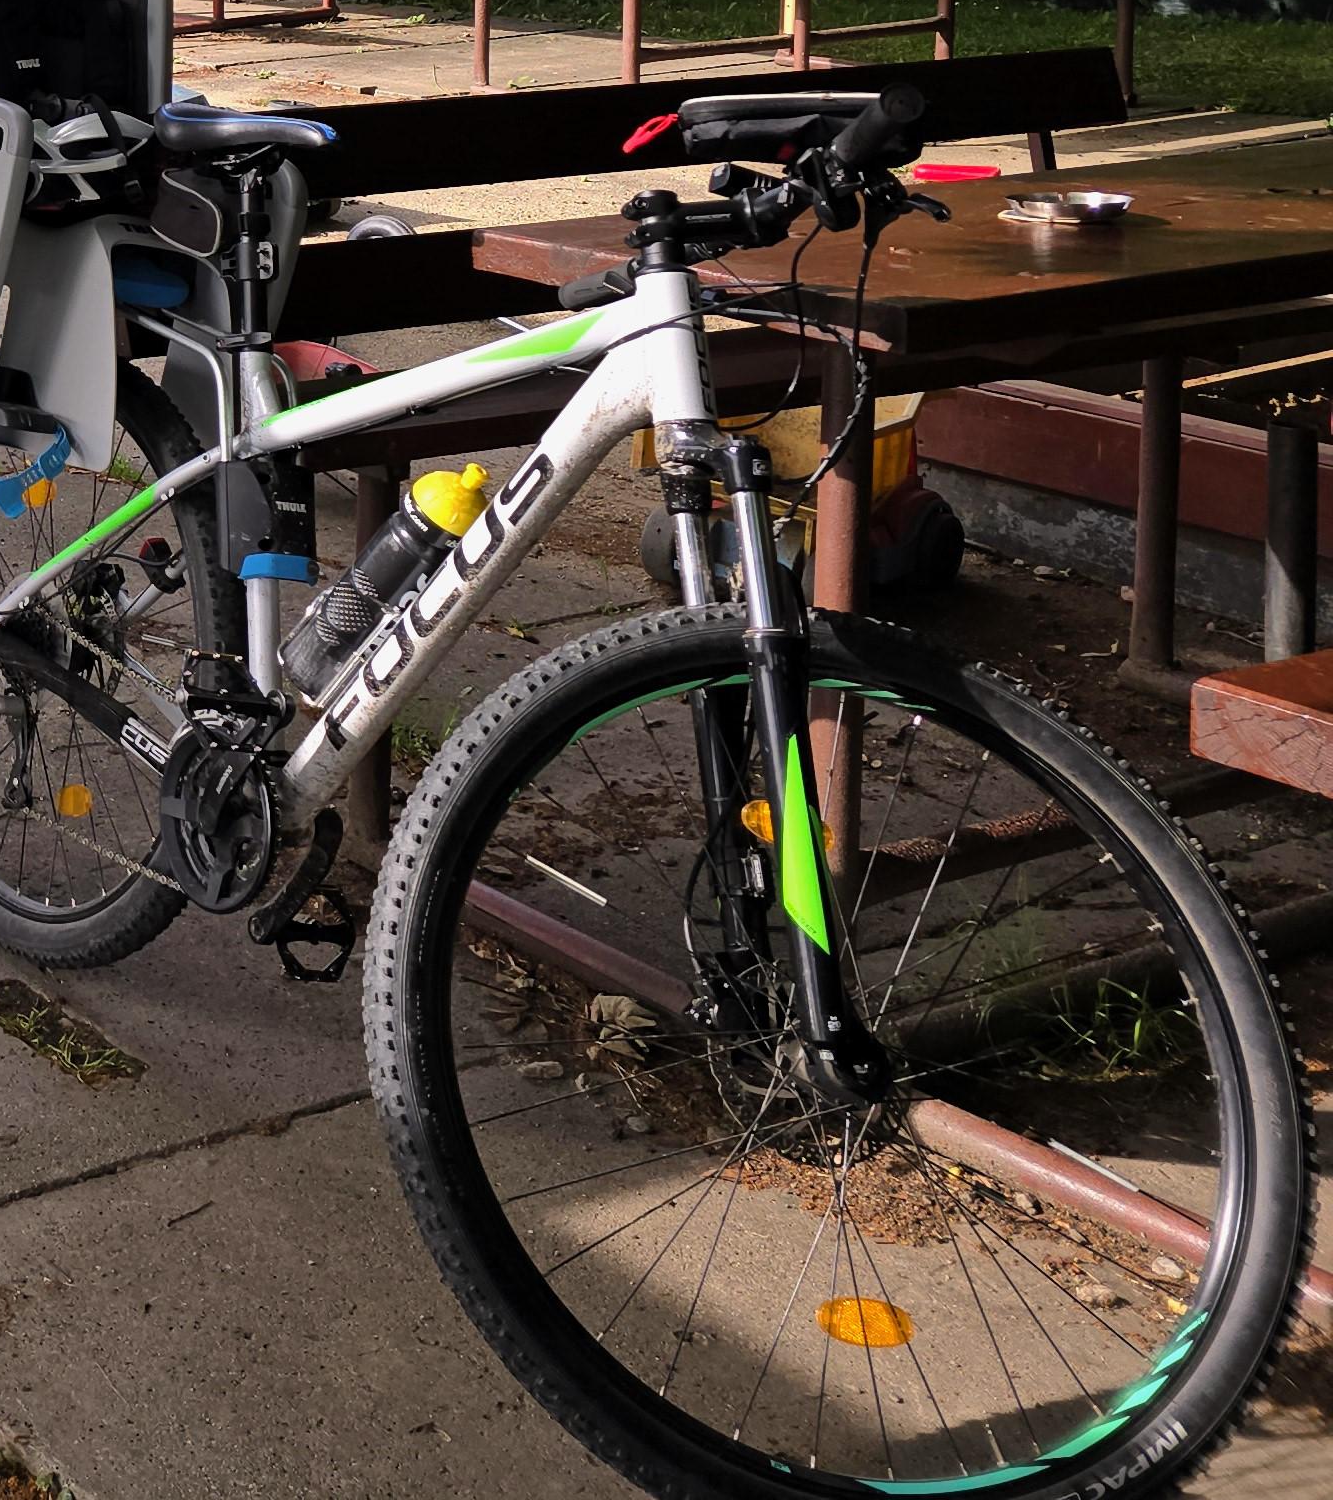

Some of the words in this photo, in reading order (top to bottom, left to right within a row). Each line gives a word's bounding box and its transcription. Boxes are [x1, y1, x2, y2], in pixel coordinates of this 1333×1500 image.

[274, 500, 307, 513] THULE
[324, 453, 555, 752] FOCUS
[1083, 1419, 1189, 1500] IMPAC
